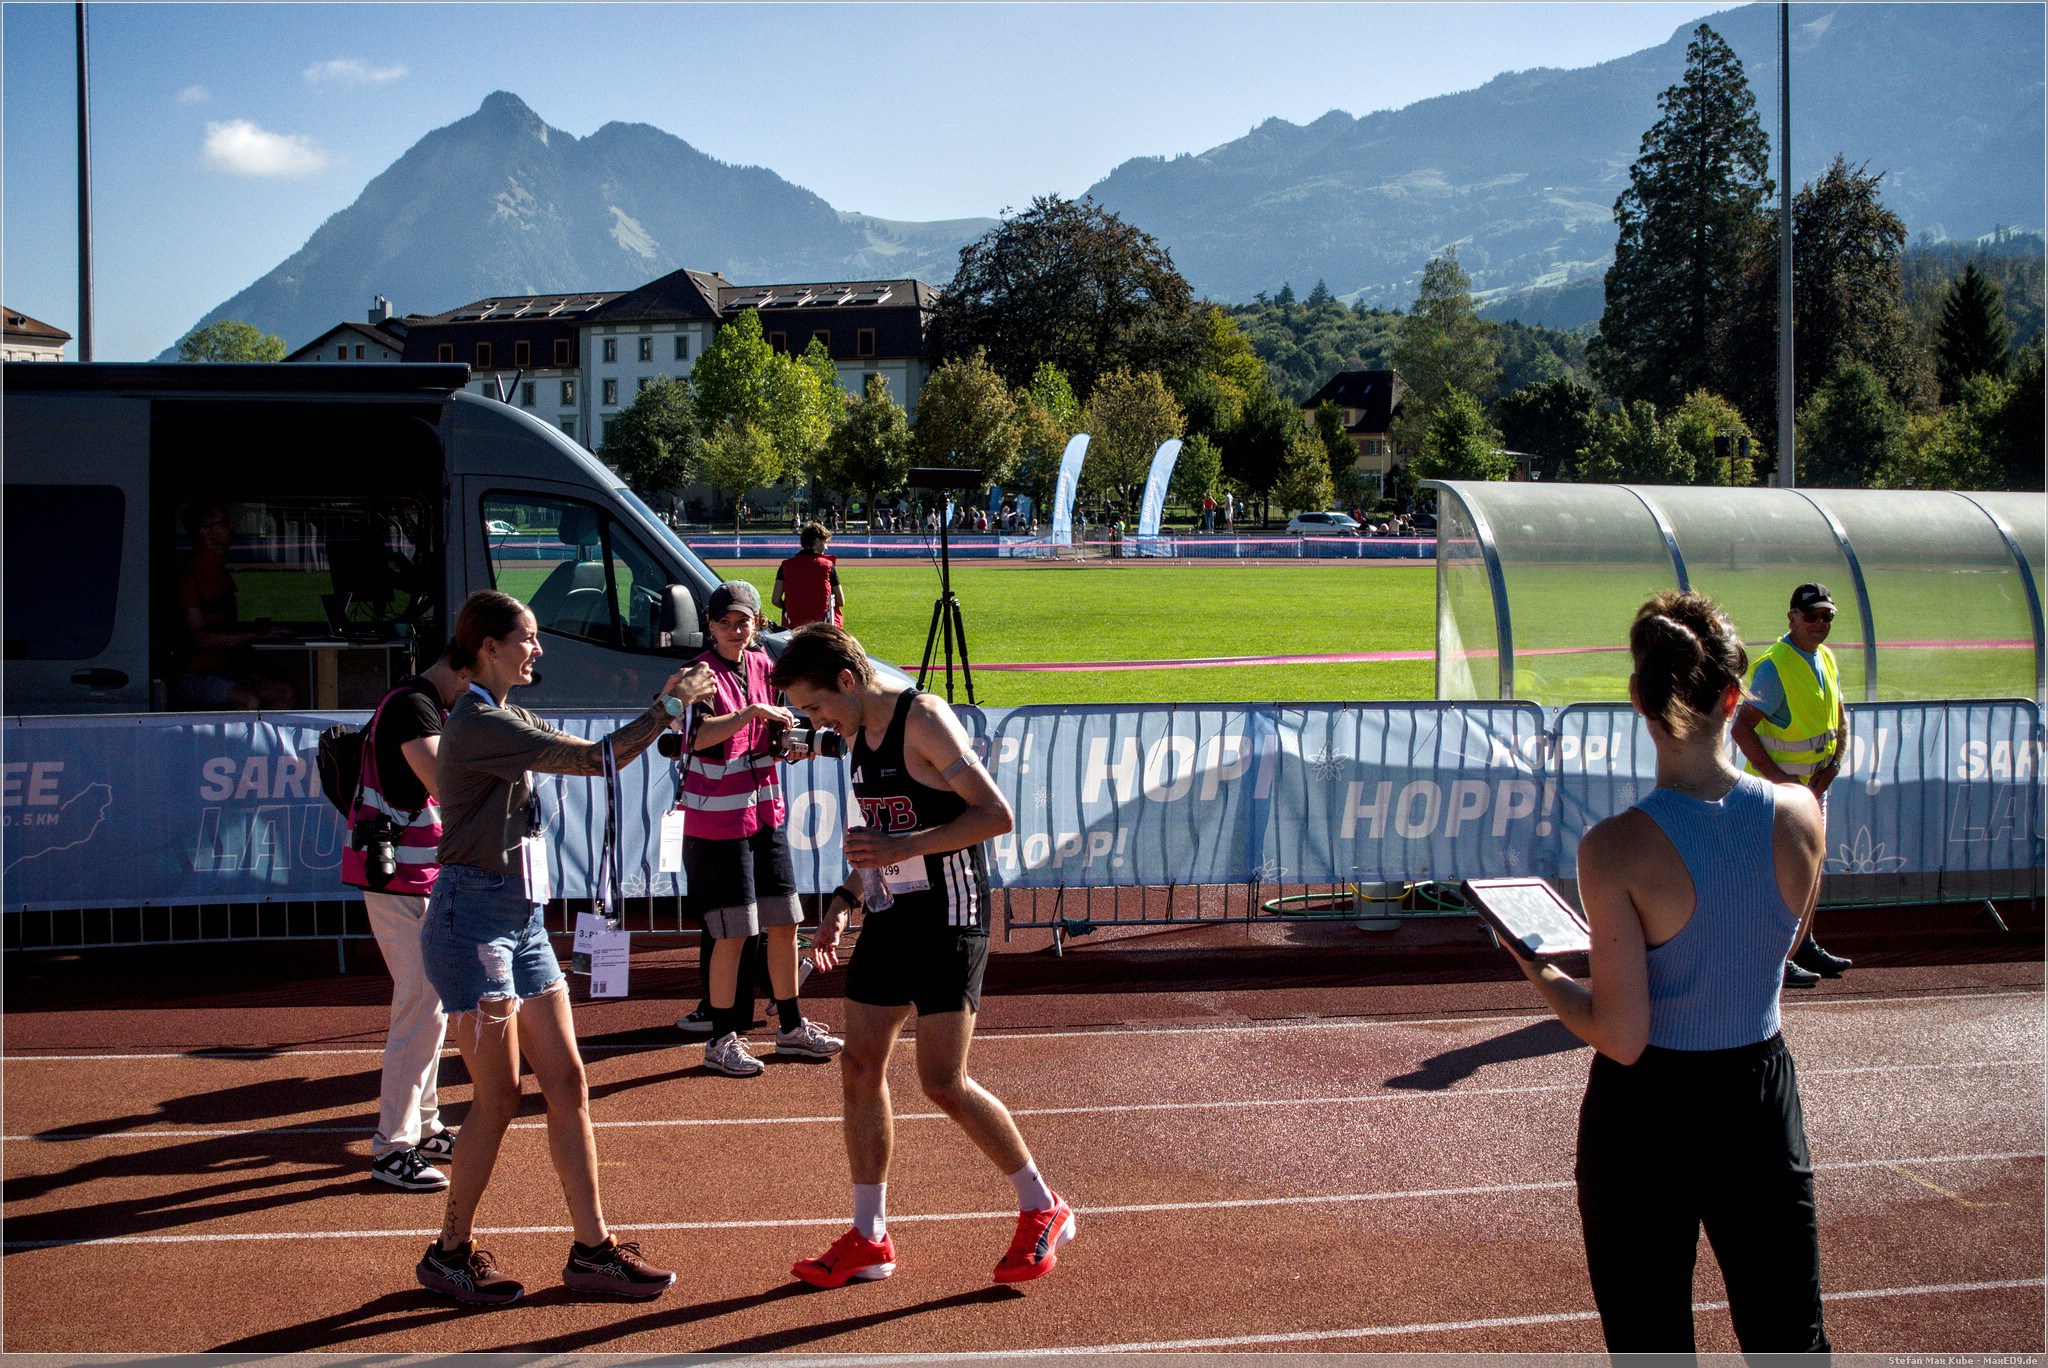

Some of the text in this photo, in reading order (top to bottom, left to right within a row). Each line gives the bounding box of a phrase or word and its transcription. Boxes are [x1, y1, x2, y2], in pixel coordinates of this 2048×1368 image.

[1340, 776, 1558, 839] HOPP!
[880, 864, 900, 876] 299
[989, 828, 1129, 870] HOPP!
